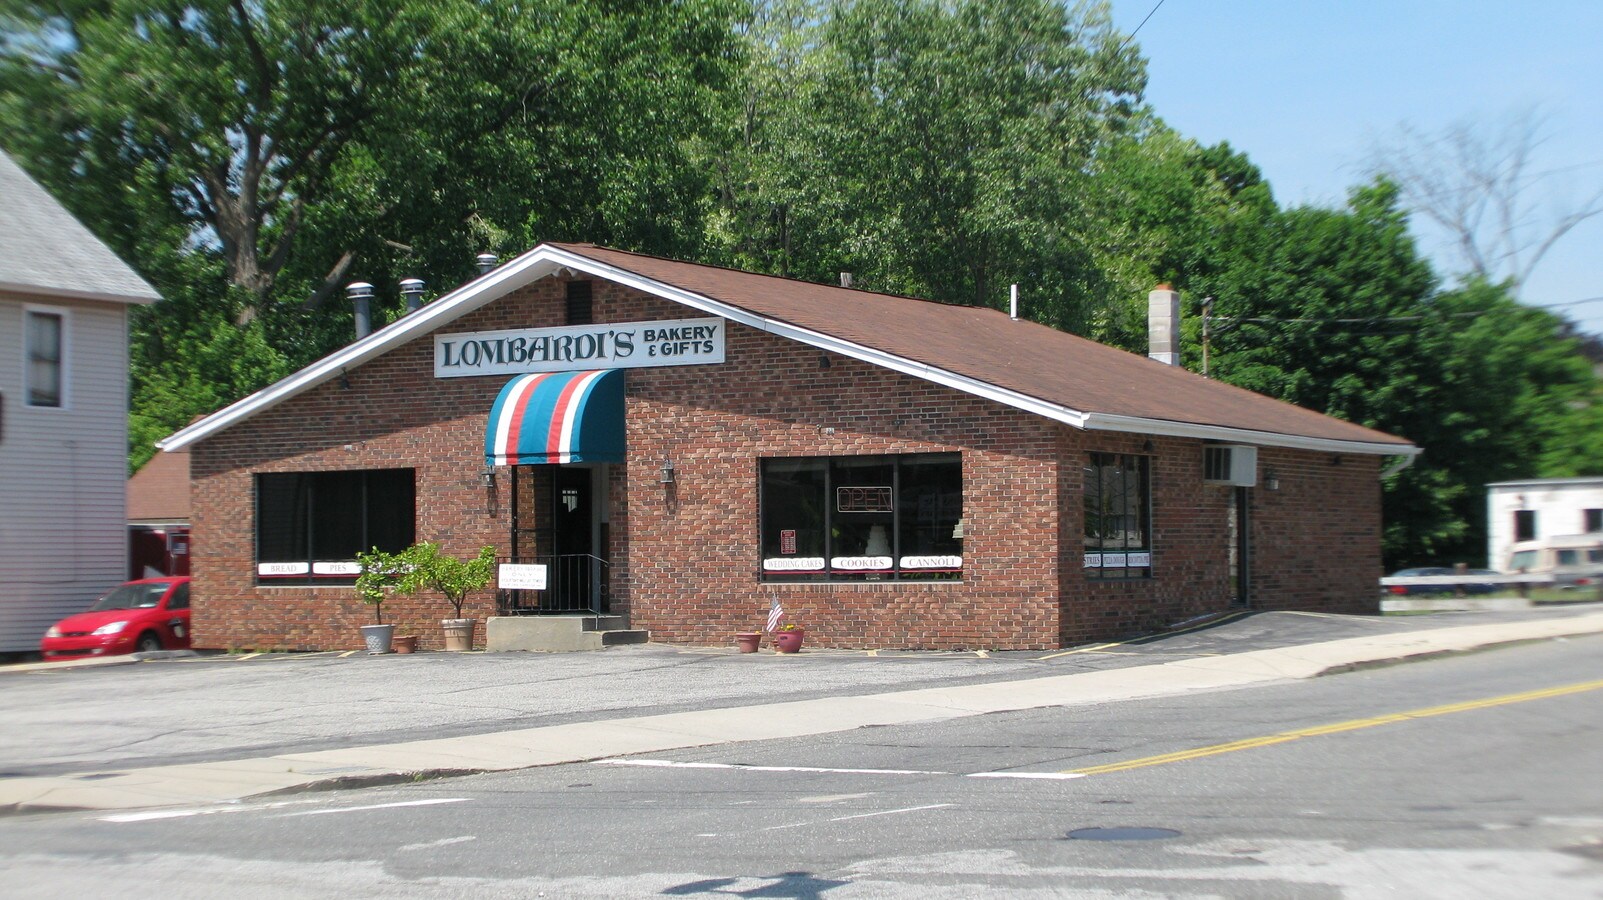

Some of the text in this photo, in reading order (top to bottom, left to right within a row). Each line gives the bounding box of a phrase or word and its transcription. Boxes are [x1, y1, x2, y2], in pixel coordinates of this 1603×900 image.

[643, 325, 718, 343] BAKERY
[441, 329, 636, 367] LOMBARDI'S
[660, 340, 715, 356] GIFTS
[839, 488, 891, 511] OPEN
[768, 559, 822, 568] WEDDING CAKES
[840, 559, 884, 567] COOKIES
[909, 558, 954, 567] CANNOLI
[270, 564, 297, 573] BREAD
[329, 564, 347, 572] PIES
